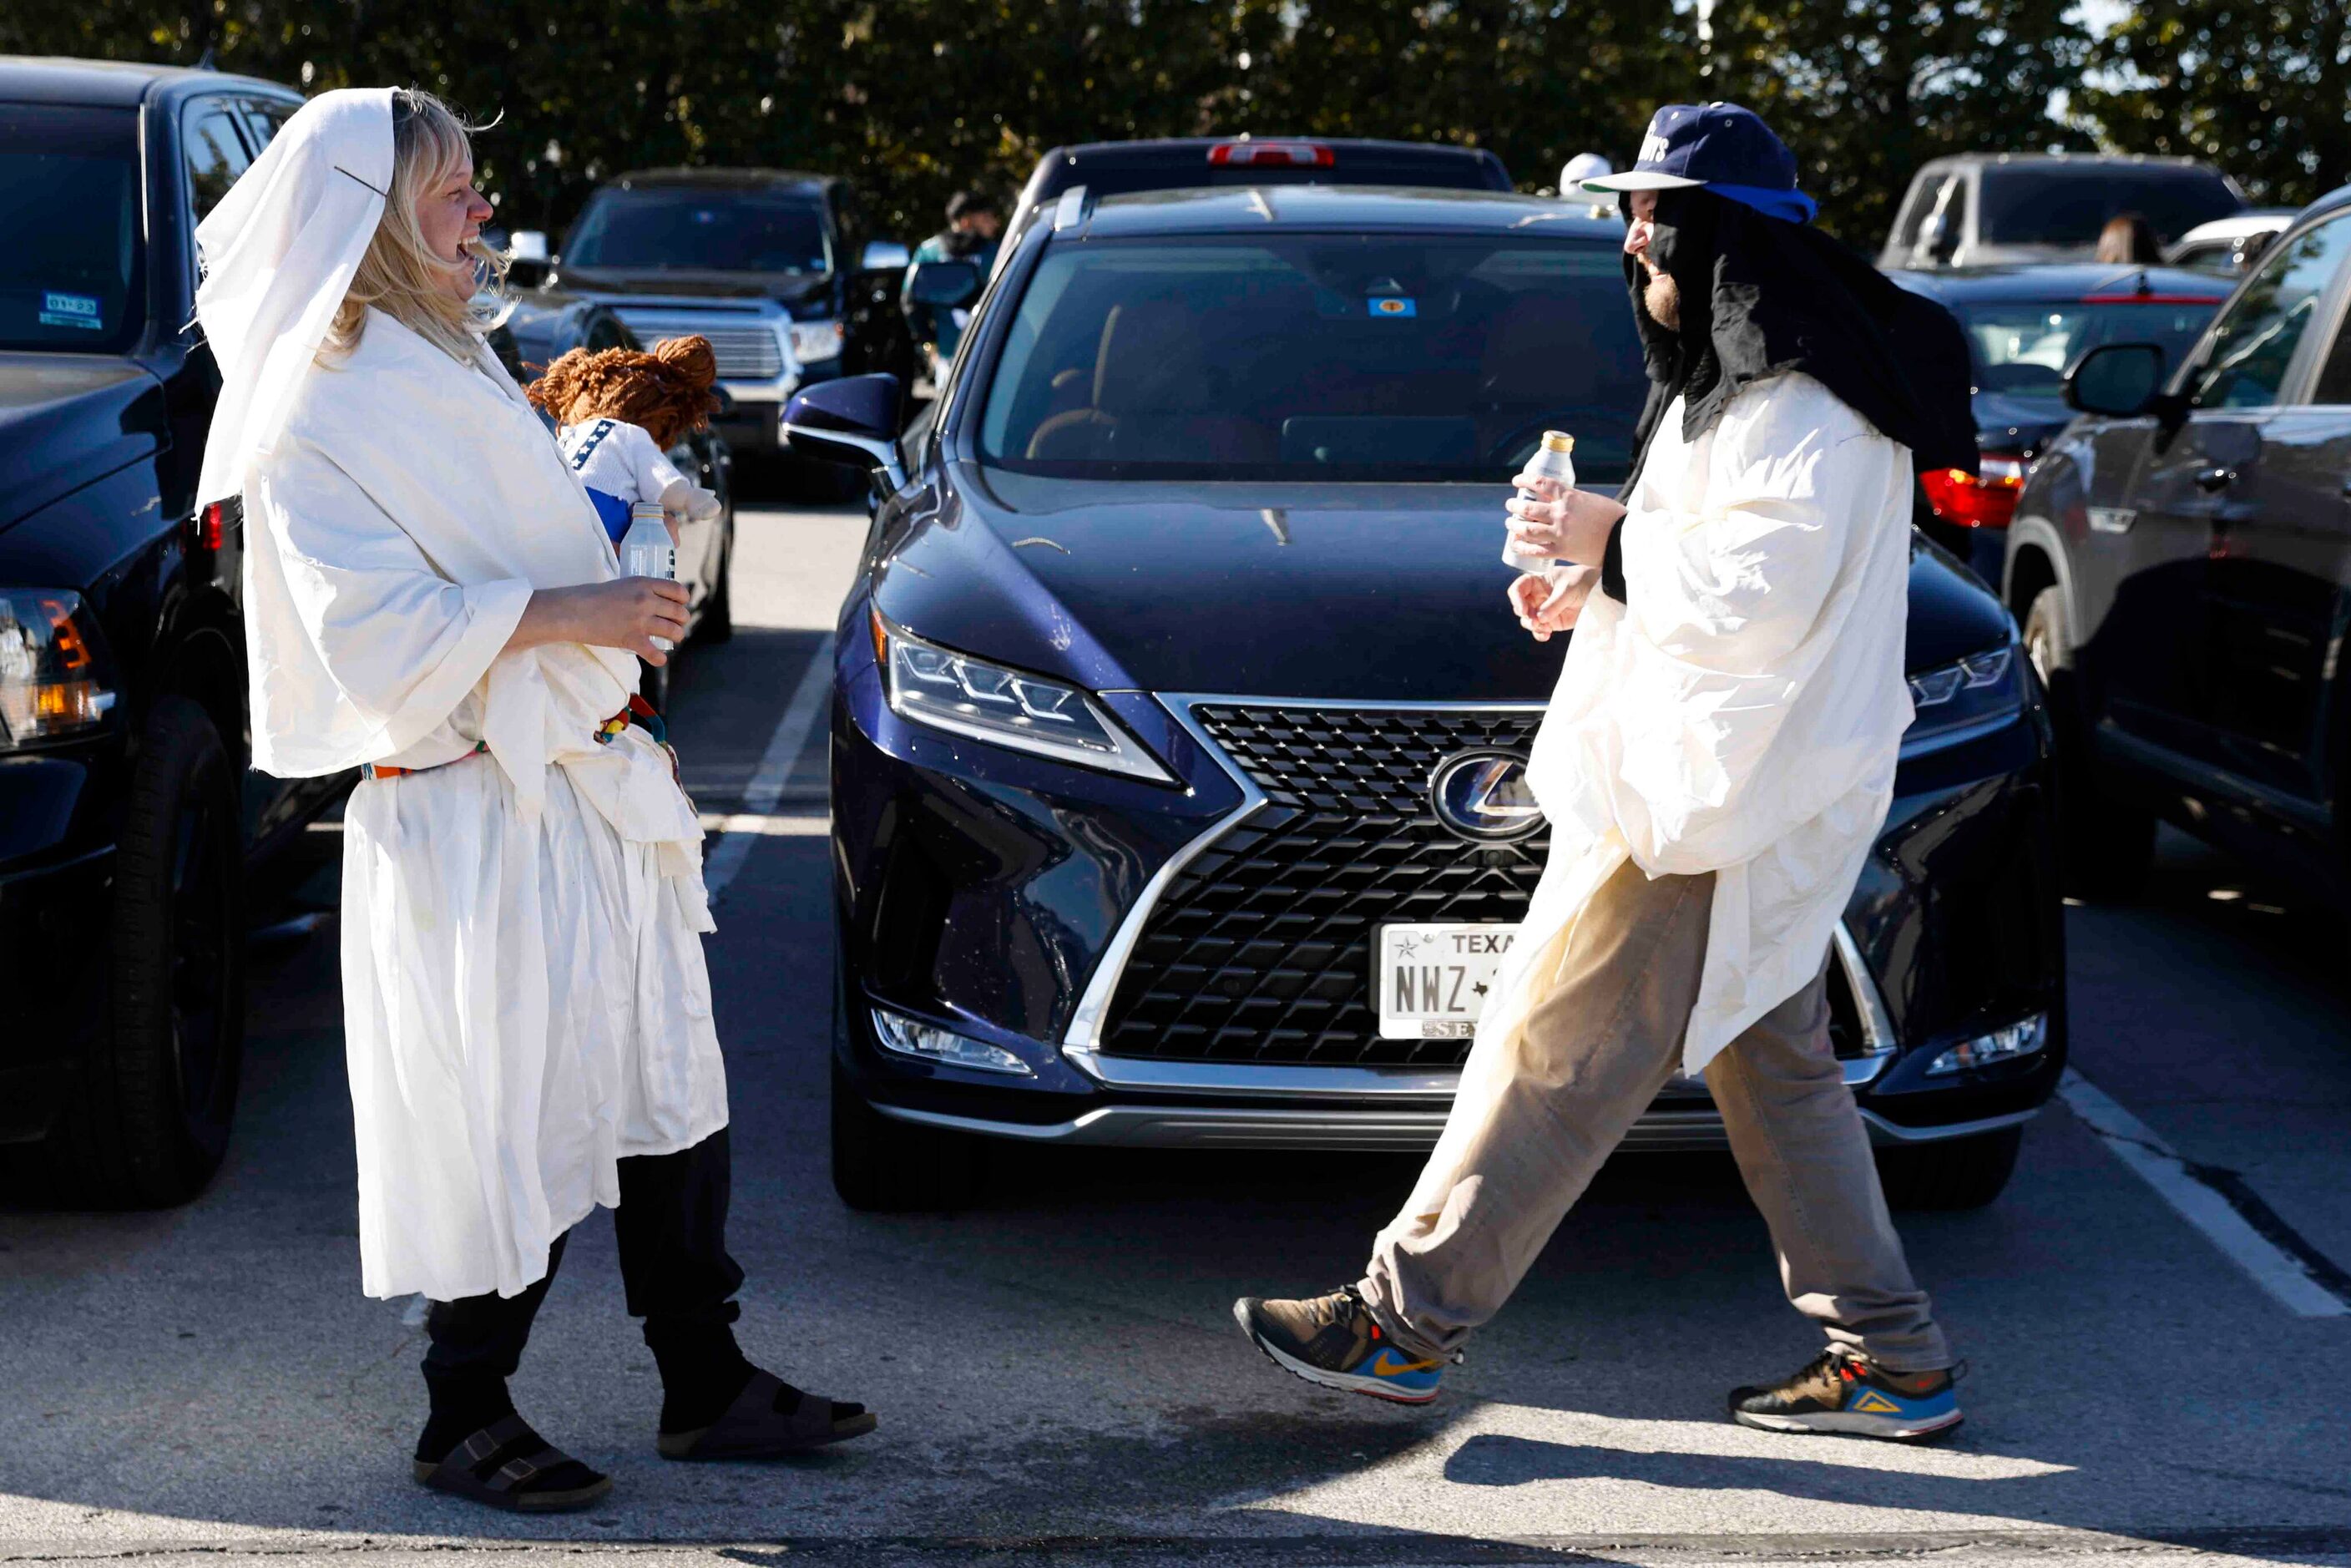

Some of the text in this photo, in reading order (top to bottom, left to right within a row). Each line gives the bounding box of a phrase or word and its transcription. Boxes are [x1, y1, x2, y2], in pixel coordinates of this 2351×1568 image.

[1451, 934, 1514, 953] TEXA
[1396, 965, 1466, 1013] NWZ
[1435, 1021, 1477, 1038] SE
